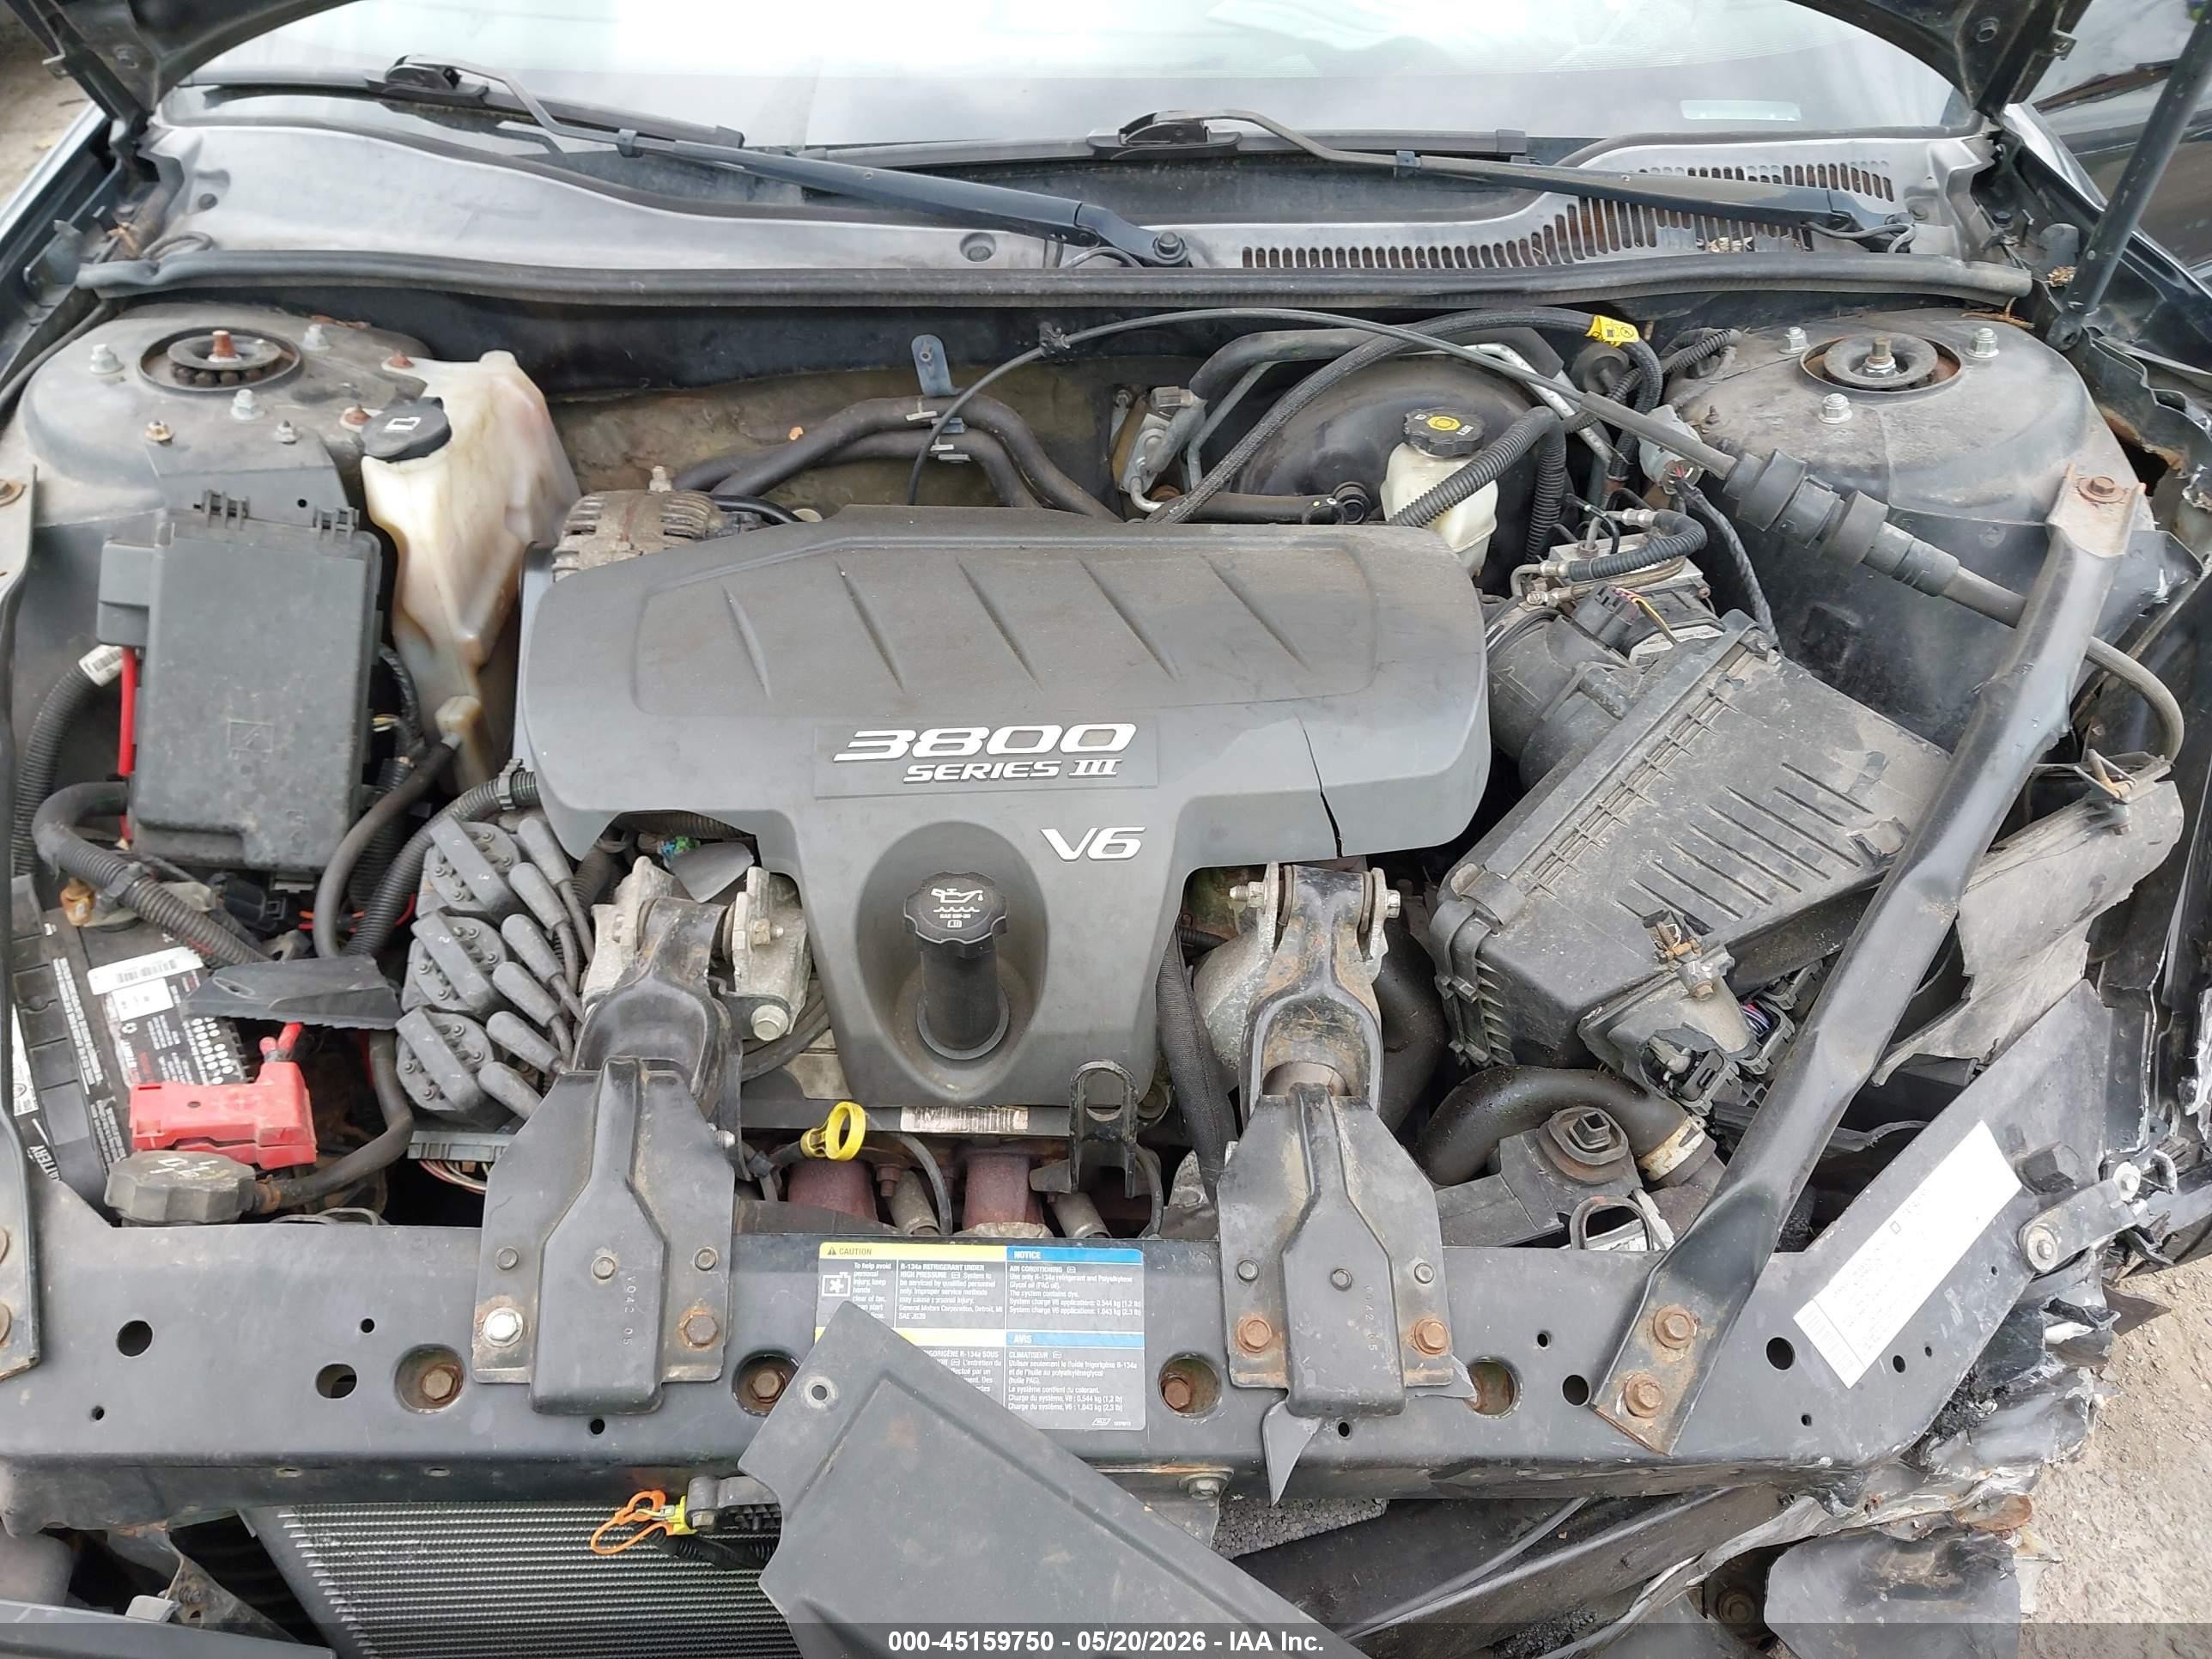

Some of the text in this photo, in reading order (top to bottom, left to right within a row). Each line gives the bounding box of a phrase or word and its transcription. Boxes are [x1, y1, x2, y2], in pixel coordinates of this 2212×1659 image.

[833, 723, 1137, 763] 3800
[903, 758, 1123, 783] SERIES III
[1041, 825, 1147, 861] V6
[1014, 1250, 1041, 1259] NOTICE
[1013, 1334, 1032, 1343] AVIS
